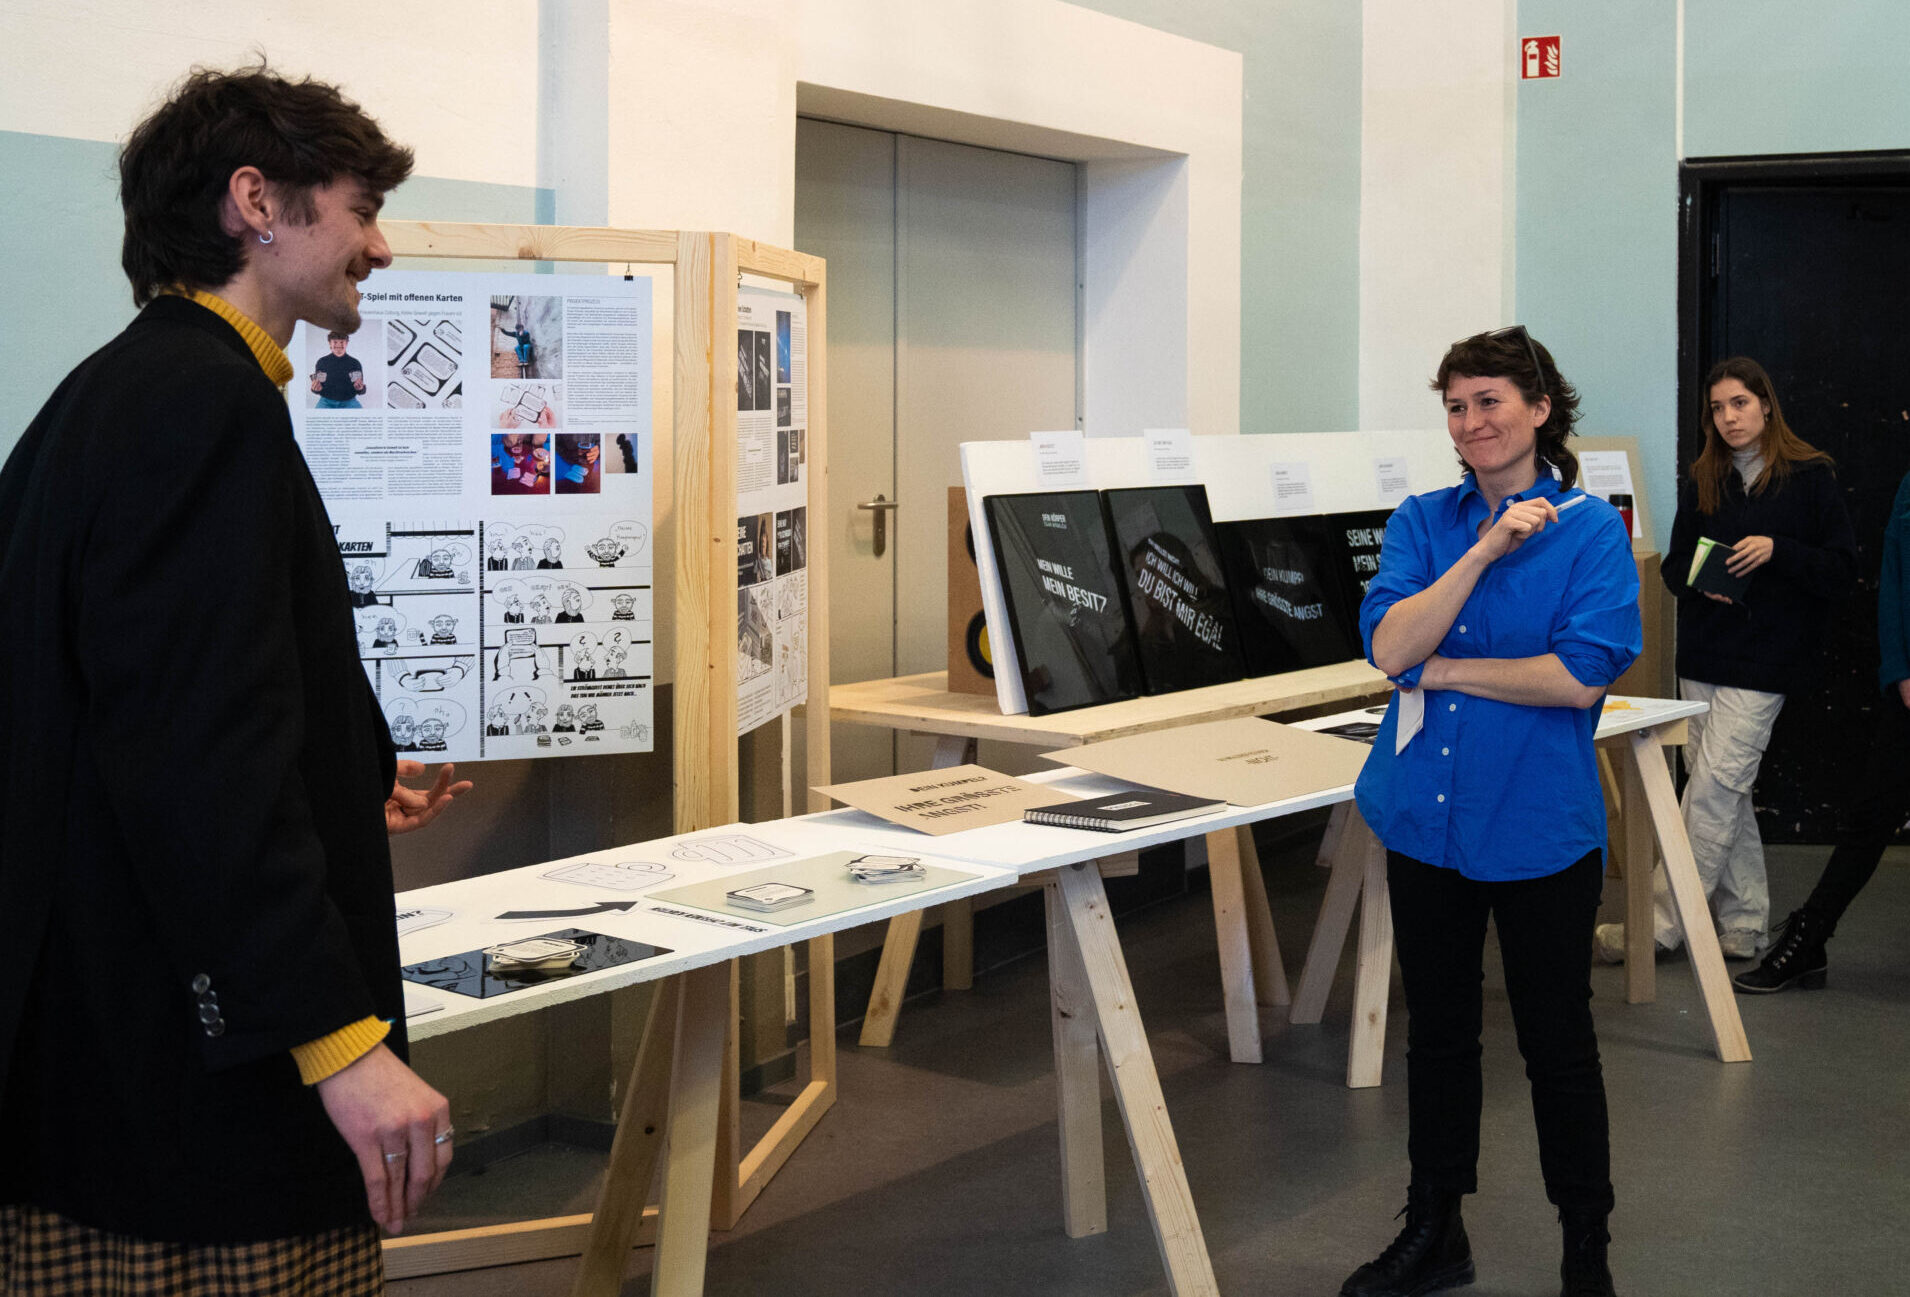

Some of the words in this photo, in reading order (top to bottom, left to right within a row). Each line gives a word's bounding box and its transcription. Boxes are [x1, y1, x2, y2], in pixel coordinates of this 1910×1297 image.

[389, 293, 403, 301] mit
[404, 293, 434, 302] offenen
[436, 294, 463, 302] Karten
[338, 541, 374, 552] KARTEN
[1346, 528, 1374, 548] SEINE
[1051, 561, 1075, 581] WILLE
[1145, 551, 1157, 567] ICH
[1157, 558, 1172, 579] WILL
[1172, 570, 1184, 588] ICH
[1042, 575, 1067, 598] MEIN
[1137, 567, 1155, 594] DU
[1153, 578, 1178, 611] BIST
[1176, 597, 1196, 631] MIR
[1293, 602, 1323, 621] ANGST
[894, 799, 942, 812] IHRE
[939, 784, 1023, 804] GRÖSSTE
